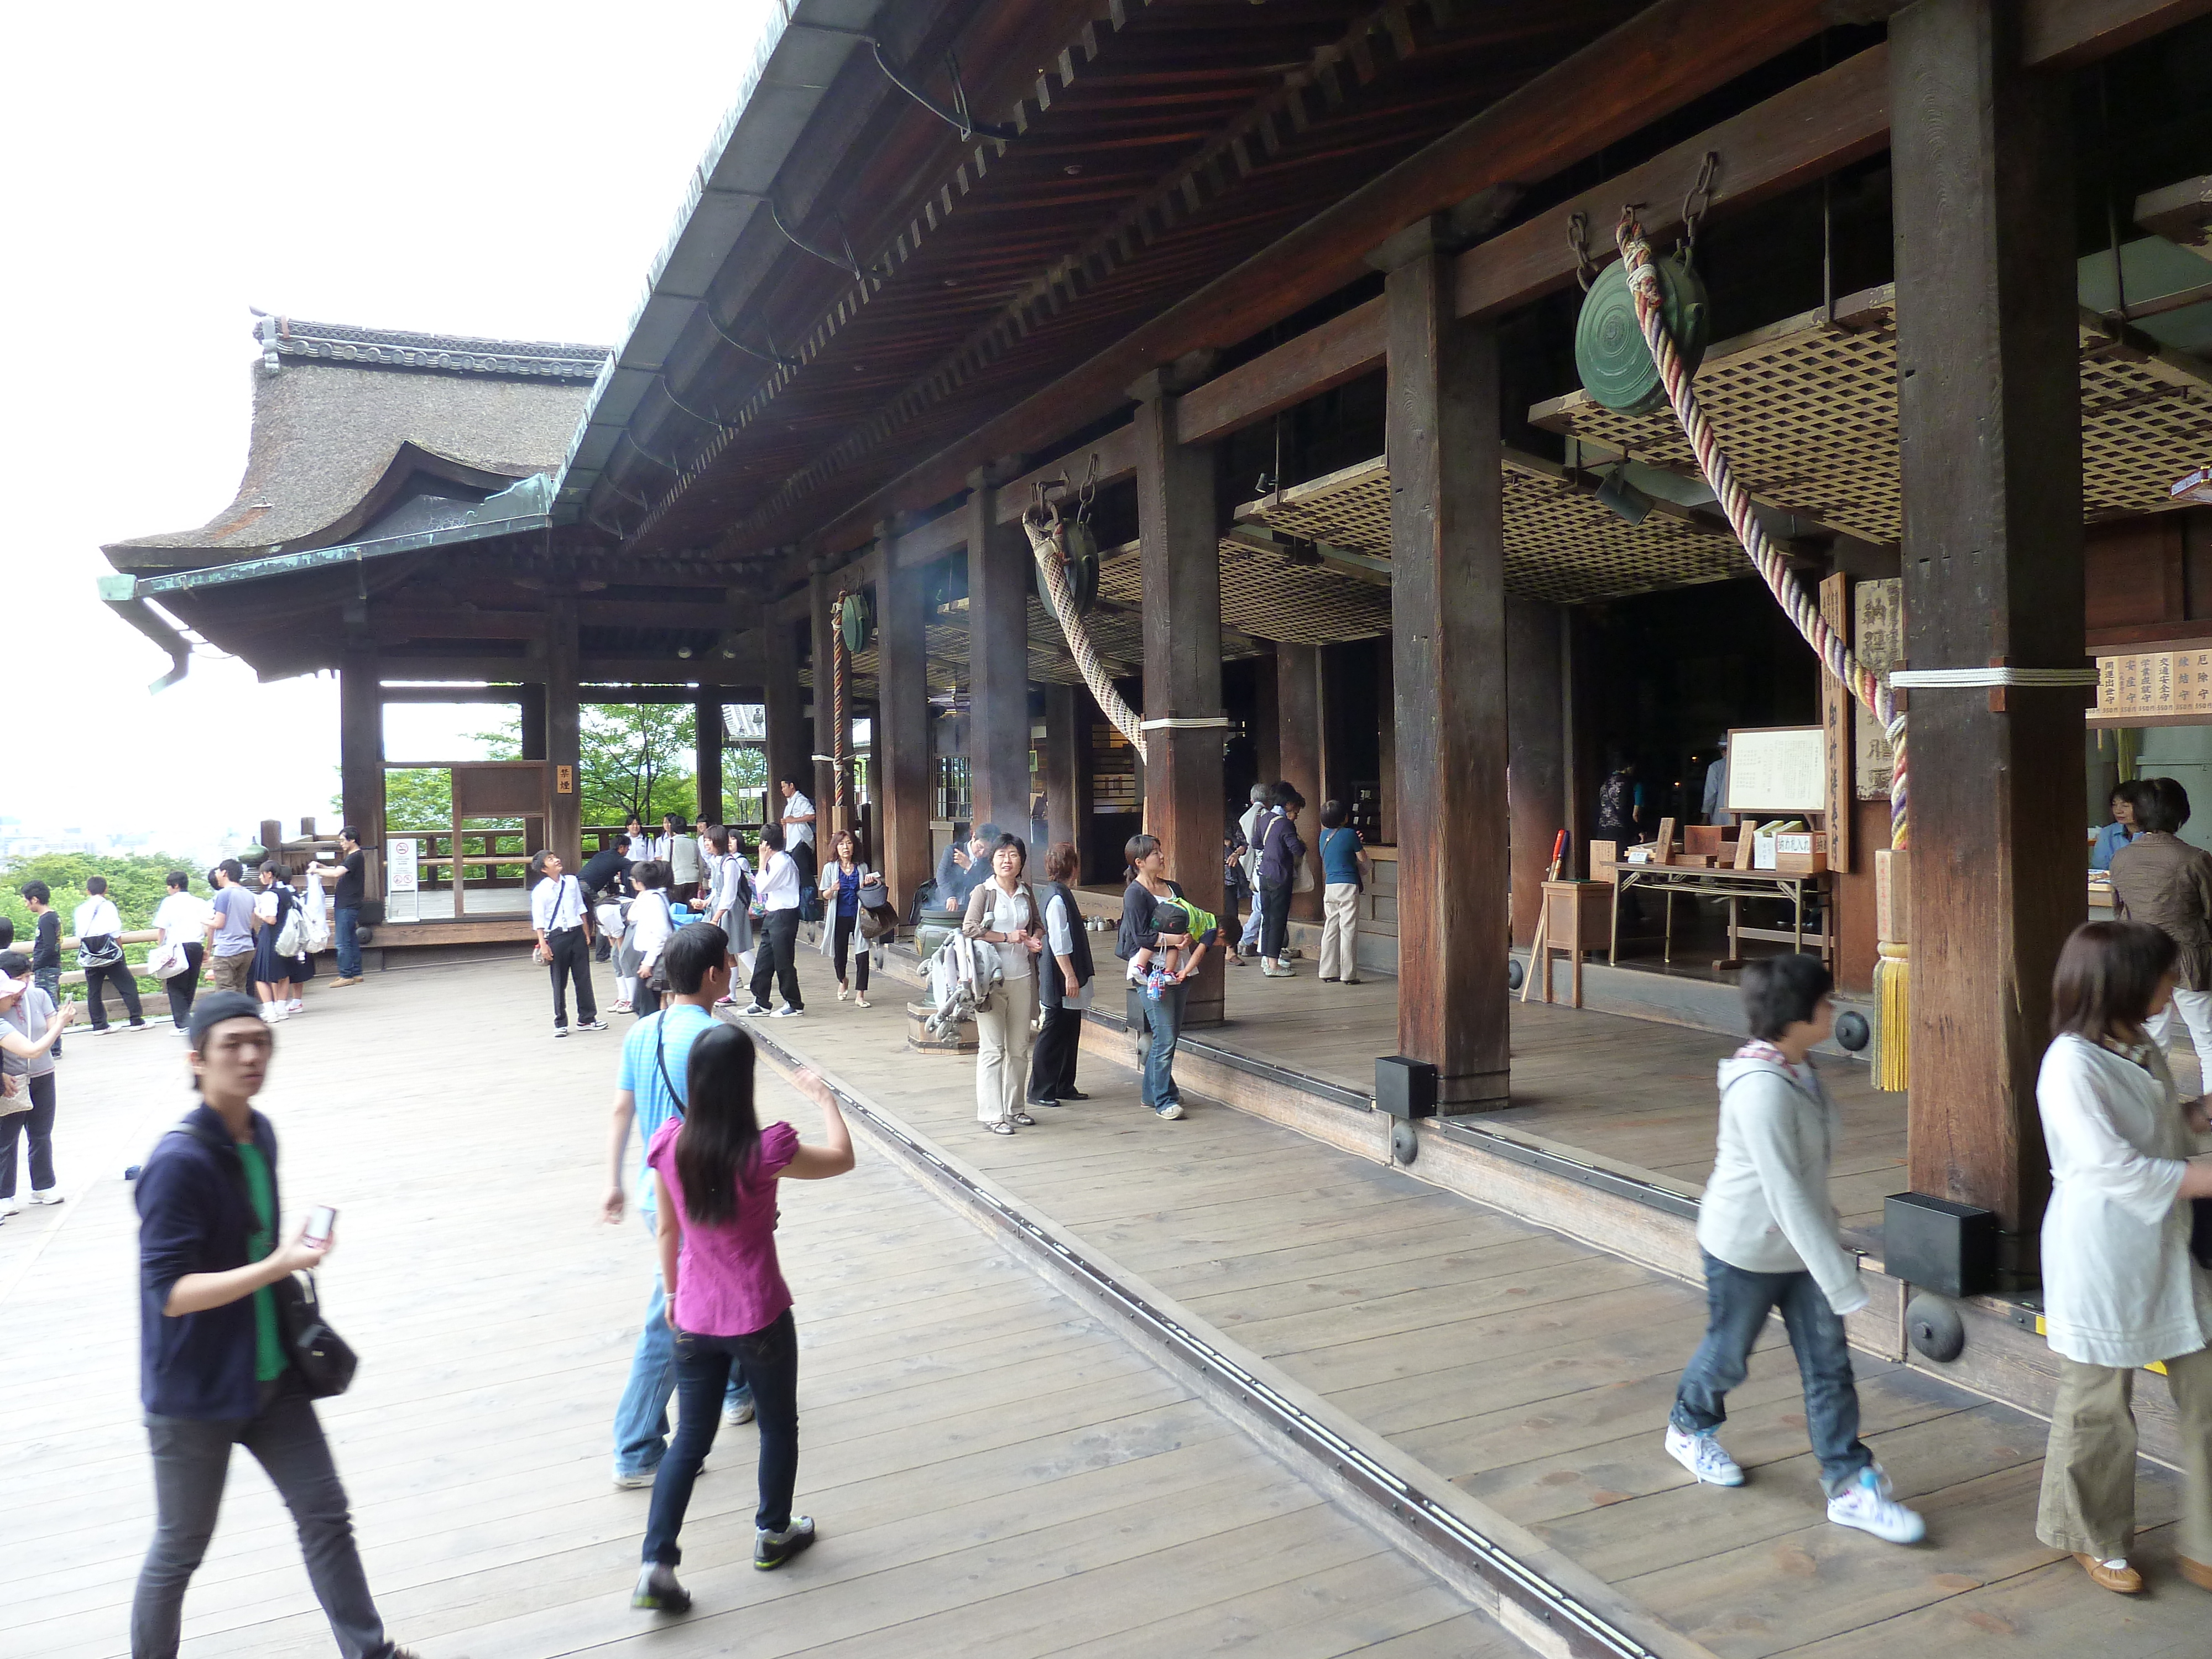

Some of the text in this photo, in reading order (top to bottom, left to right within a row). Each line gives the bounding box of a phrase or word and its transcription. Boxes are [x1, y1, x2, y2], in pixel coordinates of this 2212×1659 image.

[2104, 661, 2115, 705] 開運出世守
[2125, 660, 2136, 703] 安産守
[2158, 657, 2170, 702] 交通安全守
[2197, 654, 2209, 700] 厄除守
[560, 769, 570, 790] 禁煙
